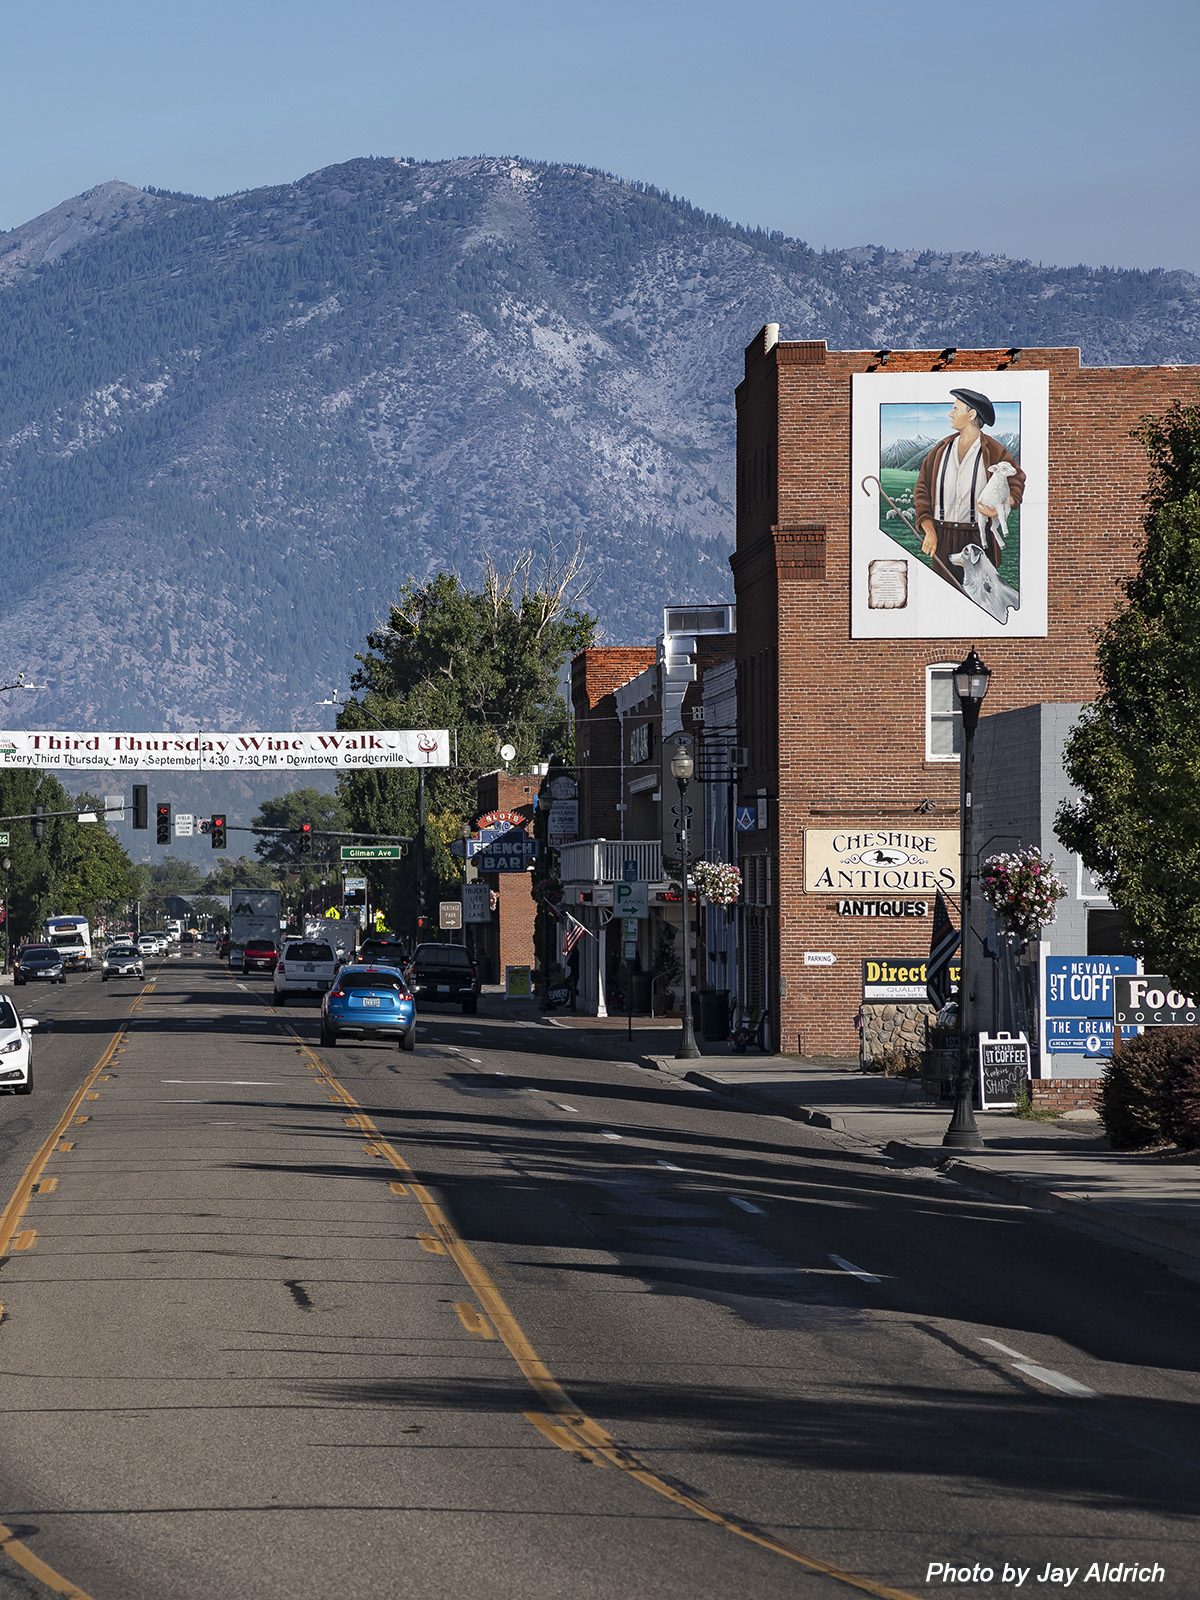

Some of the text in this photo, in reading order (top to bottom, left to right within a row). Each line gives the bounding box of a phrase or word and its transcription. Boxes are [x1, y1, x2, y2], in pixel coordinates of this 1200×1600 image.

[28, 735, 383, 755] Third Thursday Wine Walk
[5, 754, 32, 764] Every
[35, 754, 60, 764] Third
[63, 755, 109, 766] Thursday
[119, 756, 139, 766] May
[148, 755, 200, 767] September
[209, 755, 230, 765] 4:30
[239, 755, 258, 765] 7:30
[262, 755, 277, 764] PM
[287, 754, 338, 765] Downtown
[344, 753, 403, 764] Gardnerville
[486, 813, 519, 822] SLOTS
[473, 842, 532, 855] FRENCH
[832, 831, 938, 853] CHESHIRE
[349, 849, 392, 857] Gilman Ave
[484, 857, 521, 869] BAR
[814, 866, 956, 890] ANTIQUES
[841, 901, 927, 916] ANTIQUES
[866, 961, 927, 982] Direct
[1071, 962, 1112, 975] NEVADA
[1070, 974, 1113, 1002] COFF
[1052, 1021, 1071, 1034] THE
[995, 1050, 1026, 1063] COFFEE
